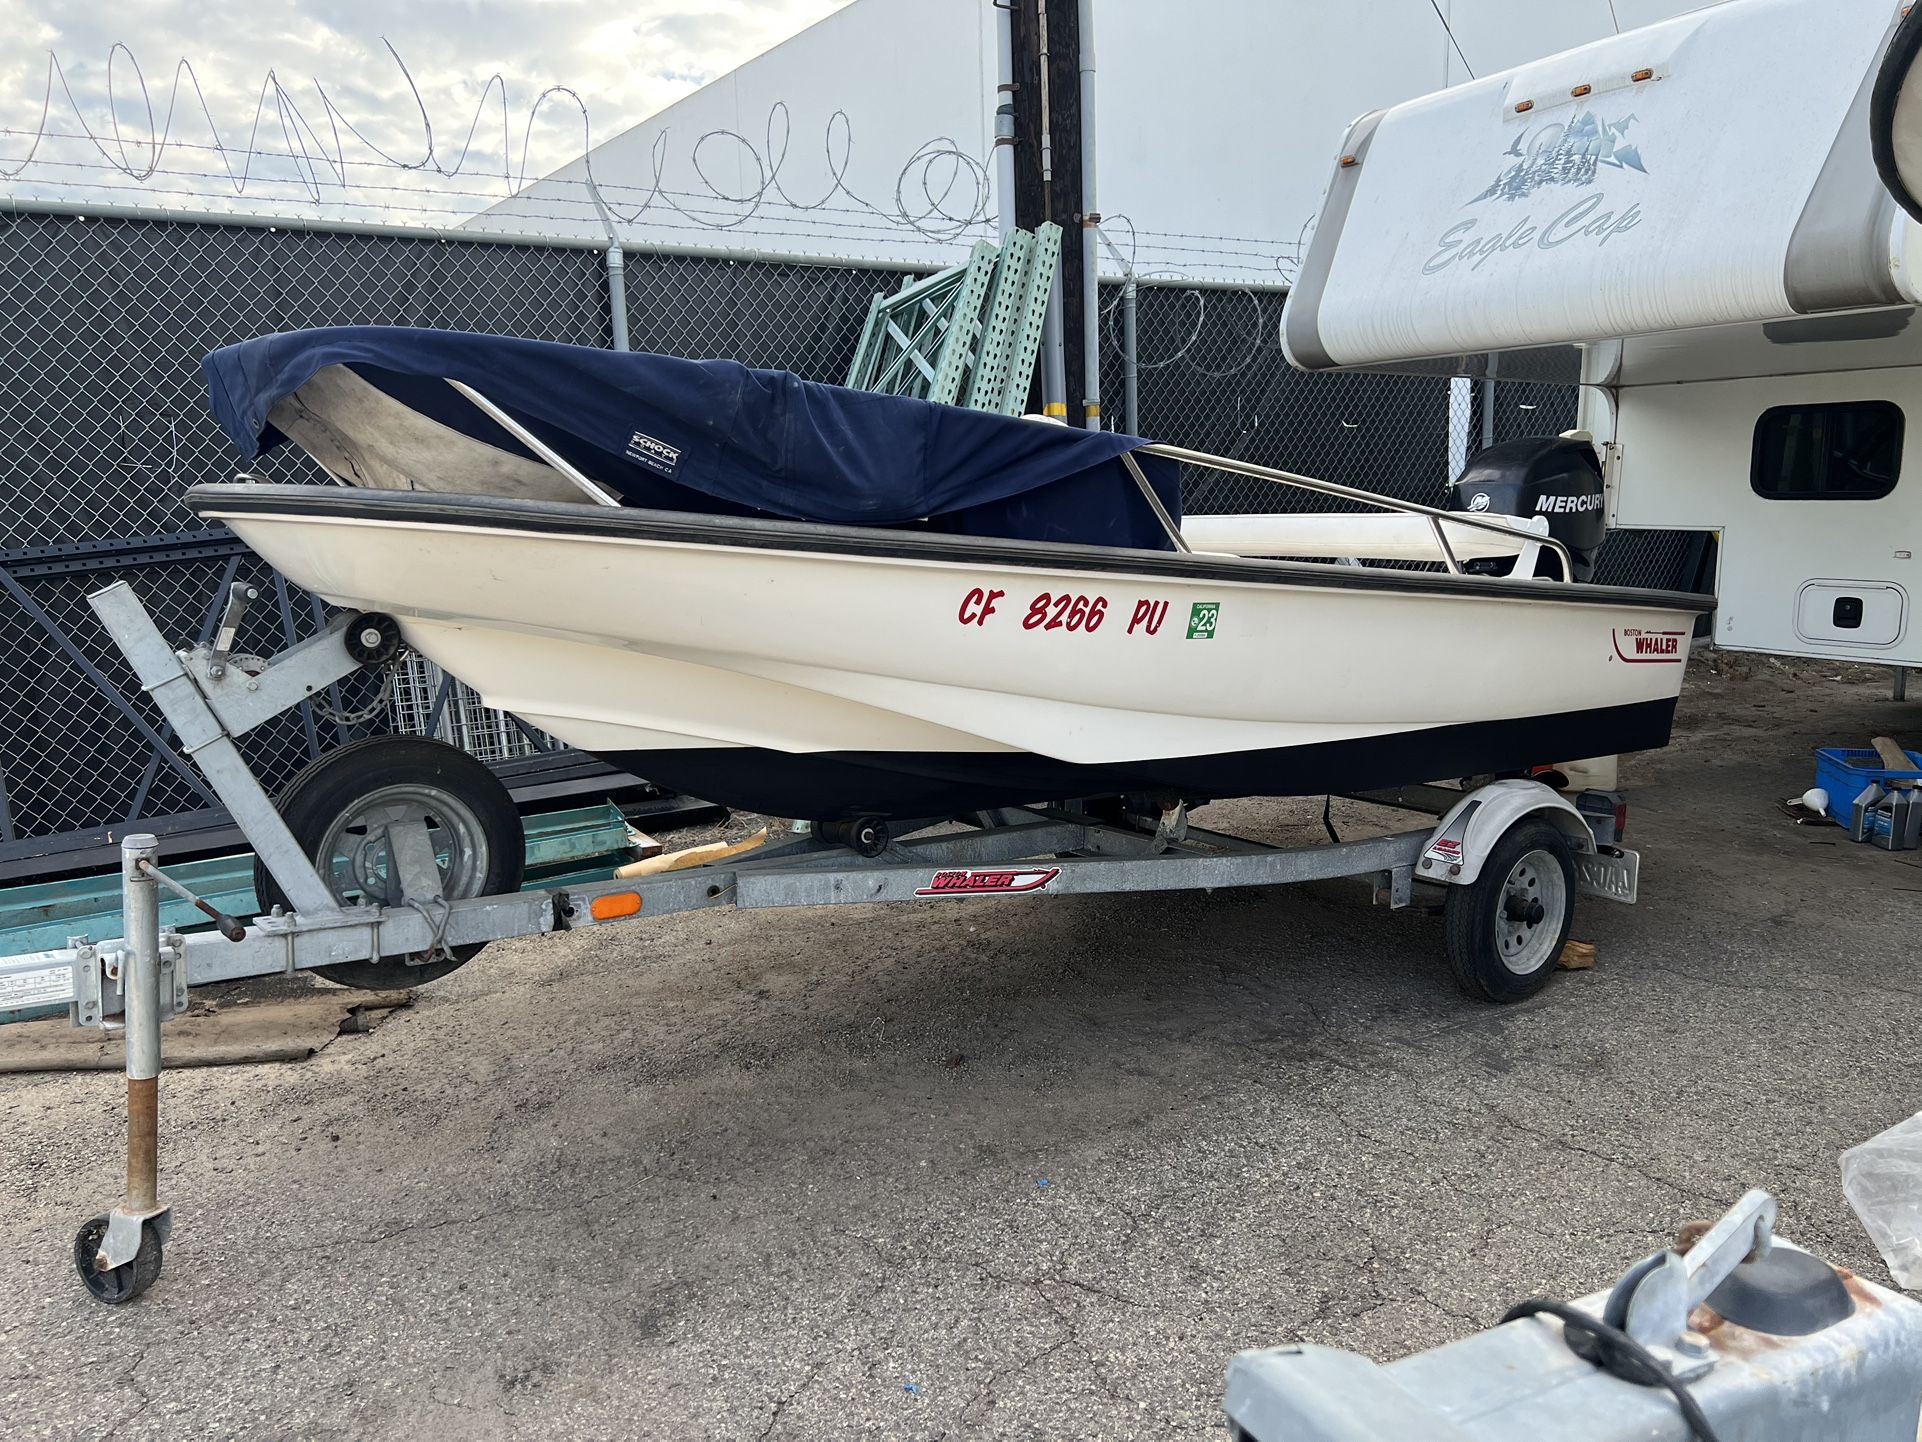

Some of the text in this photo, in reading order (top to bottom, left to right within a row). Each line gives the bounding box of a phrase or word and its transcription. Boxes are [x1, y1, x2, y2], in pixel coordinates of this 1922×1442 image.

[1421, 192, 1642, 276] Eagle Cap
[632, 435, 679, 460] SCHOCK
[625, 450, 648, 462] NEWPORT
[647, 460, 664, 470] BEACH
[1535, 493, 1604, 513] MERCURY
[958, 587, 1169, 636] CF 8266 PU
[1196, 609, 1217, 631] 23
[1623, 628, 1642, 637] BOSTON
[1635, 637, 1678, 654] WHALER
[931, 874, 1015, 889] WHALER
